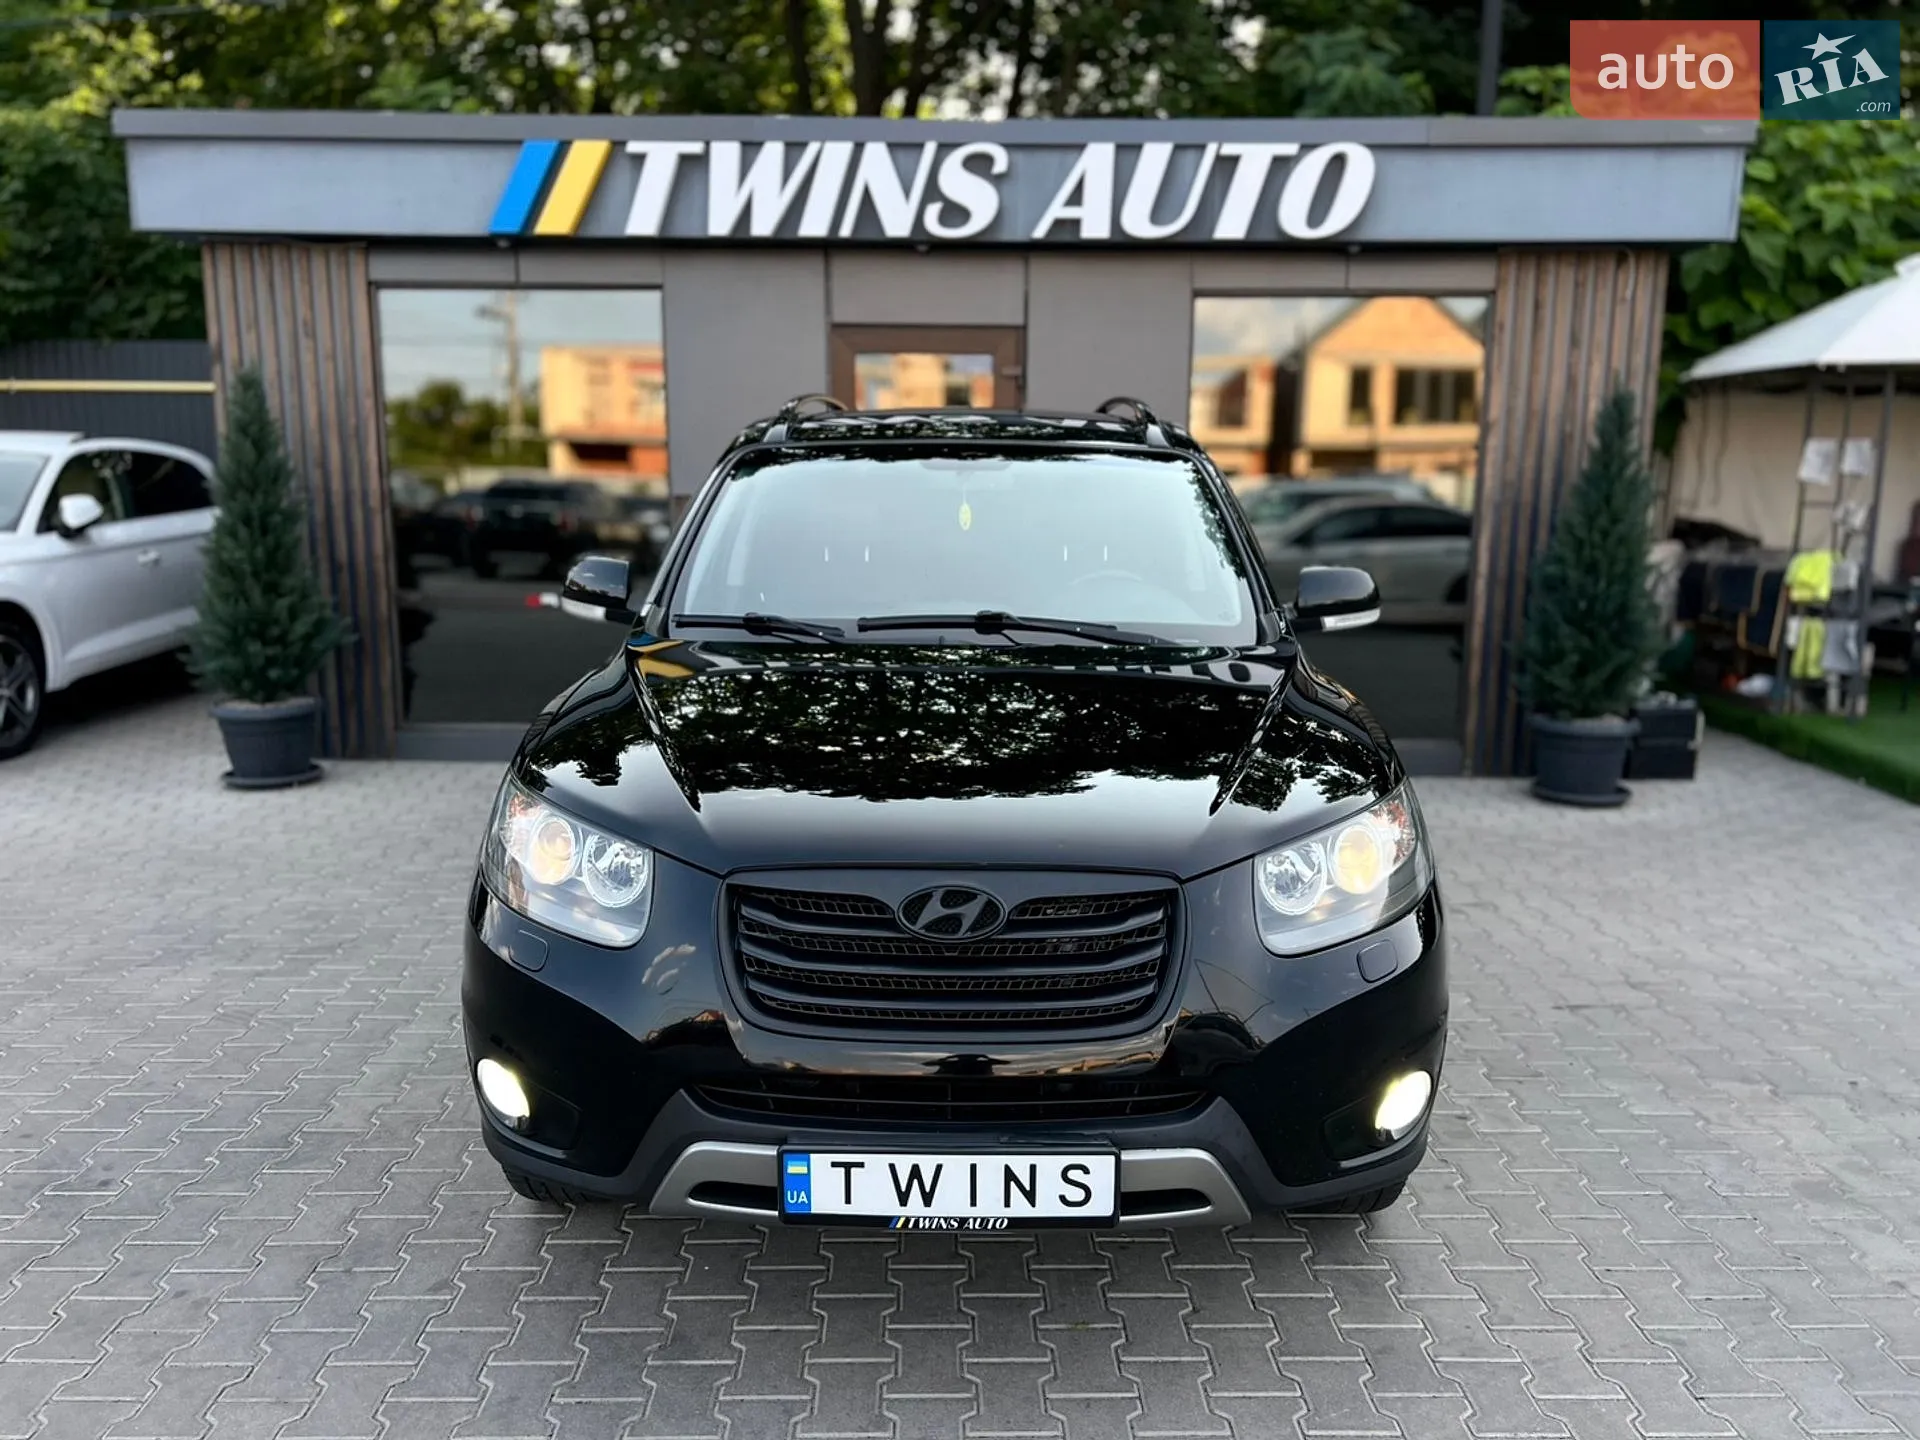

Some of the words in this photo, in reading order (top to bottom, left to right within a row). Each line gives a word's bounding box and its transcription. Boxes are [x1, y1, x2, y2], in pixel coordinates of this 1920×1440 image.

[624, 140, 1010, 240] TWINS
[1030, 140, 1377, 241] AUTO
[787, 1190, 809, 1205] UA
[906, 1216, 959, 1230] TWINS
[962, 1216, 1009, 1230] AUTO
